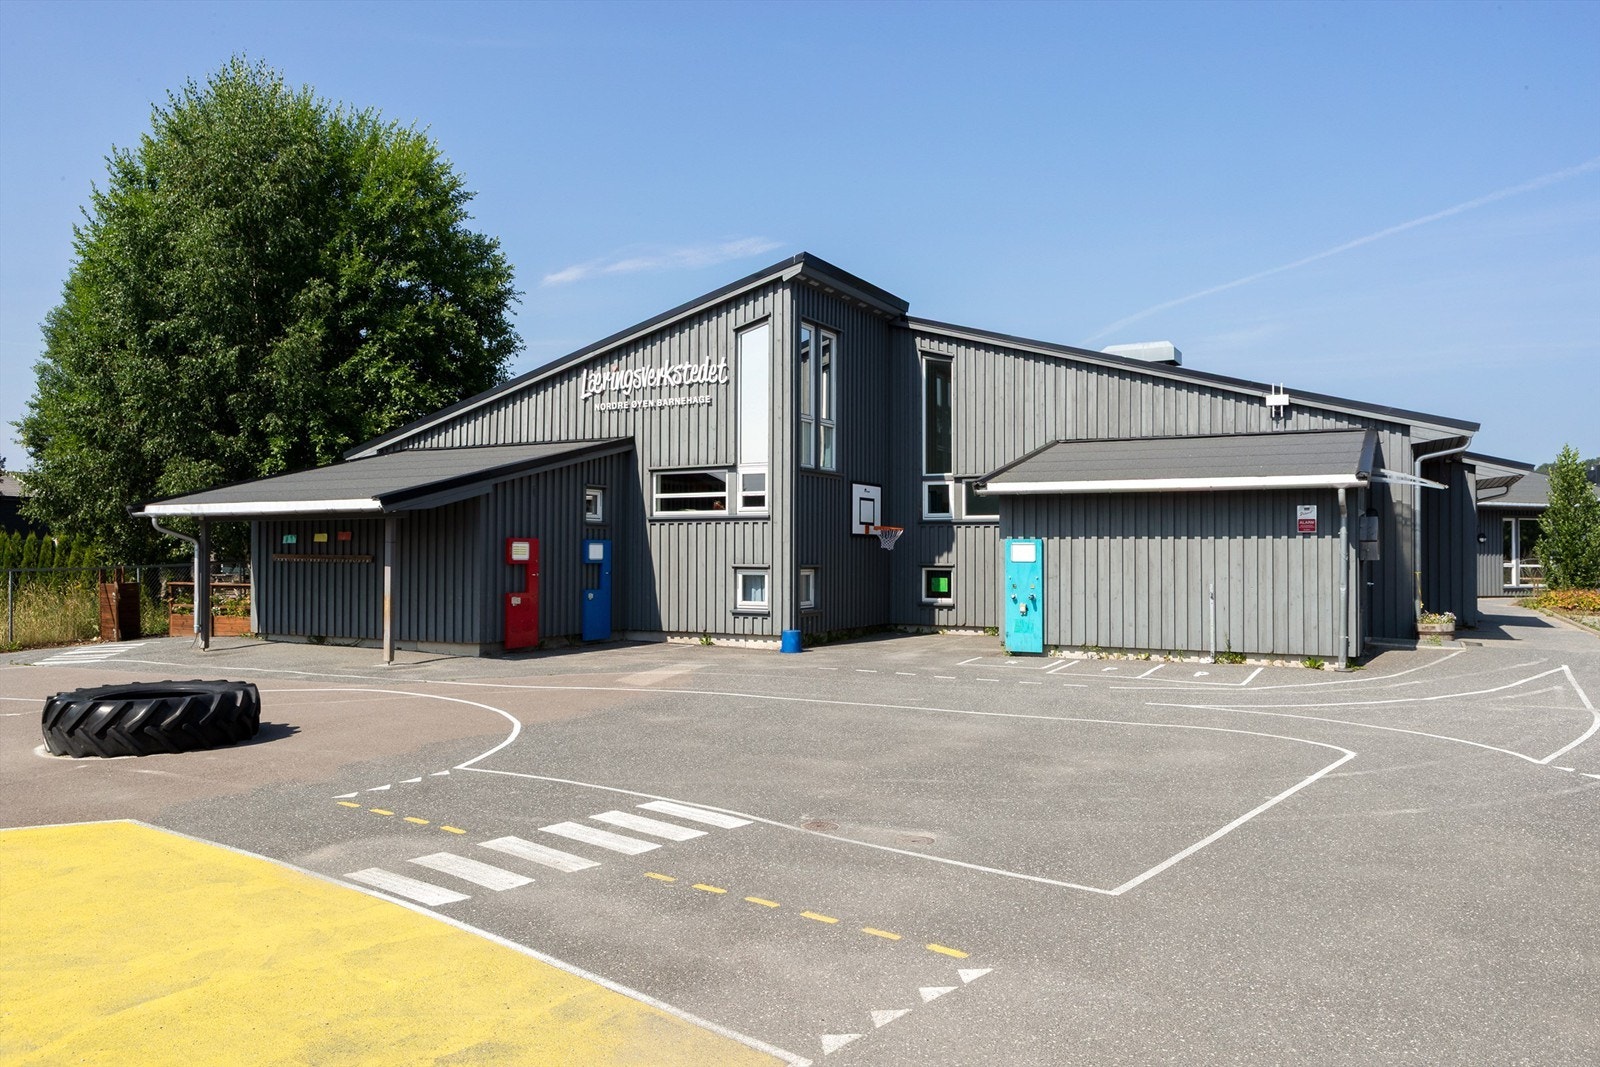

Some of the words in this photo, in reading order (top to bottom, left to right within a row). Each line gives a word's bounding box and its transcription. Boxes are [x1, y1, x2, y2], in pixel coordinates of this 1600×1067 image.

[594, 401, 629, 411] NORDRE
[631, 399, 655, 409] ØYEN
[657, 395, 711, 407] BARNEHAGE
